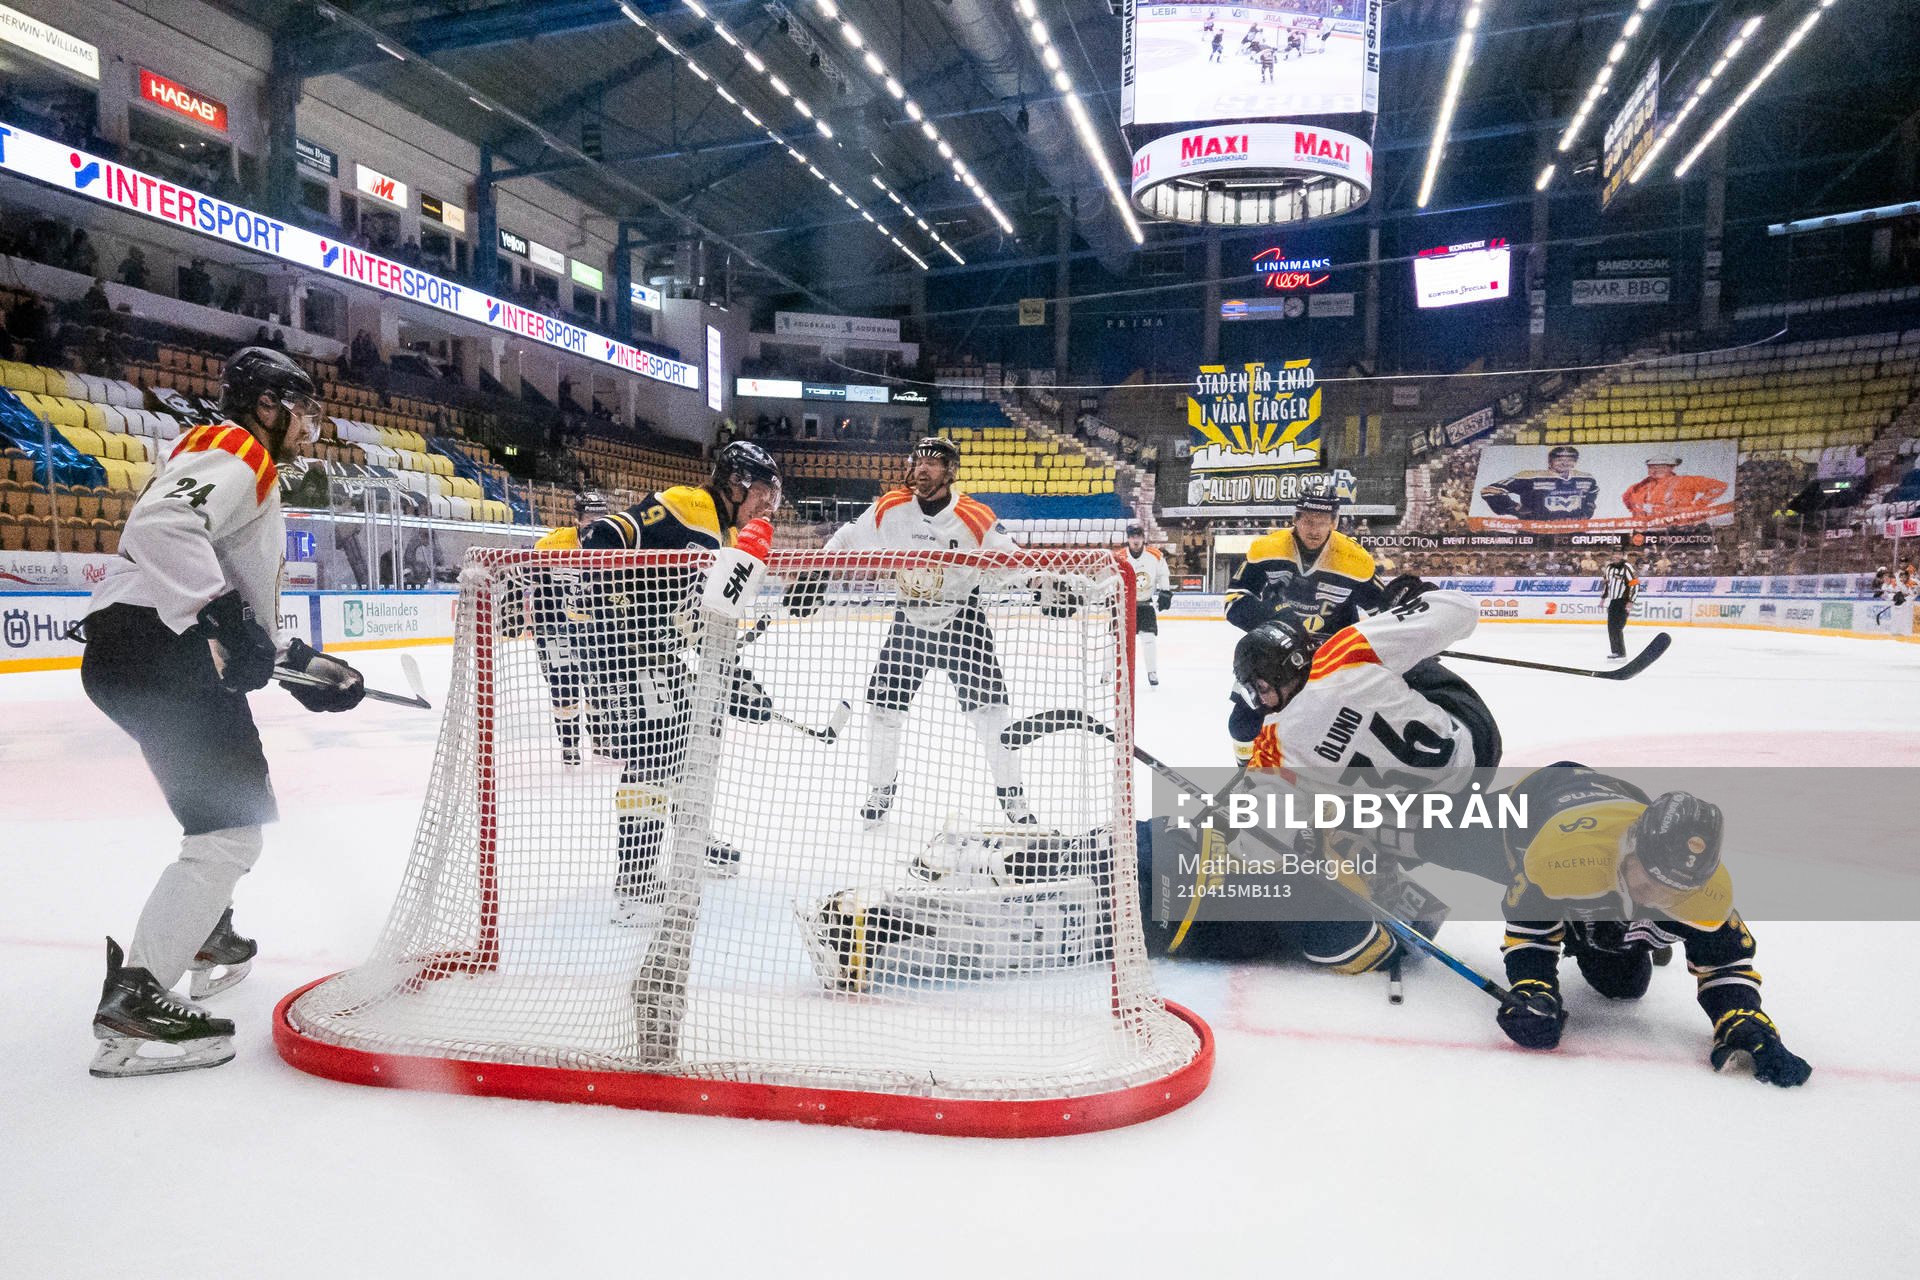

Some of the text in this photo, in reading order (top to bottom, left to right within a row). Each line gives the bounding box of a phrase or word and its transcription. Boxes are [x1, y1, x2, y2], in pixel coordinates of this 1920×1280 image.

[0, 12, 93, 62] HERWIN-WILLIAMS
[151, 79, 214, 121] HAGAB
[1181, 135, 1249, 161] MAXI
[1294, 131, 1350, 163] MAXI
[106, 164, 285, 253] INTERSPORT
[1256, 257, 1331, 272] LINNMANS
[343, 249, 462, 311] INTERSPORT
[1628, 279, 1668, 296] BBQ
[502, 303, 587, 353] INTERSPORT
[617, 343, 688, 384] INTERSPORT
[1196, 366, 1315, 395] STADEN ÄR ENAD
[1201, 396, 1308, 424] I VÅRA FÄRGER
[164, 477, 217, 508] 24
[1209, 475, 1250, 501] ALLTID
[1254, 474, 1278, 500] VID
[1360, 536, 1439, 548] PRODUCTION
[1442, 537, 1466, 545] EVENT
[1519, 537, 1534, 545] LED
[1572, 535, 1621, 544] GRUPPEN
[1645, 535, 1716, 544] FC PRODUCTION
[723, 562, 754, 606] SHL
[366, 601, 418, 617] Hallanders
[1695, 604, 1747, 618] SUBWAY
[405, 619, 418, 632] AB
[1313, 706, 1364, 763] ÖLUND
[1548, 856, 1615, 870] FAGERHULT
[1685, 854, 1697, 868] 3
